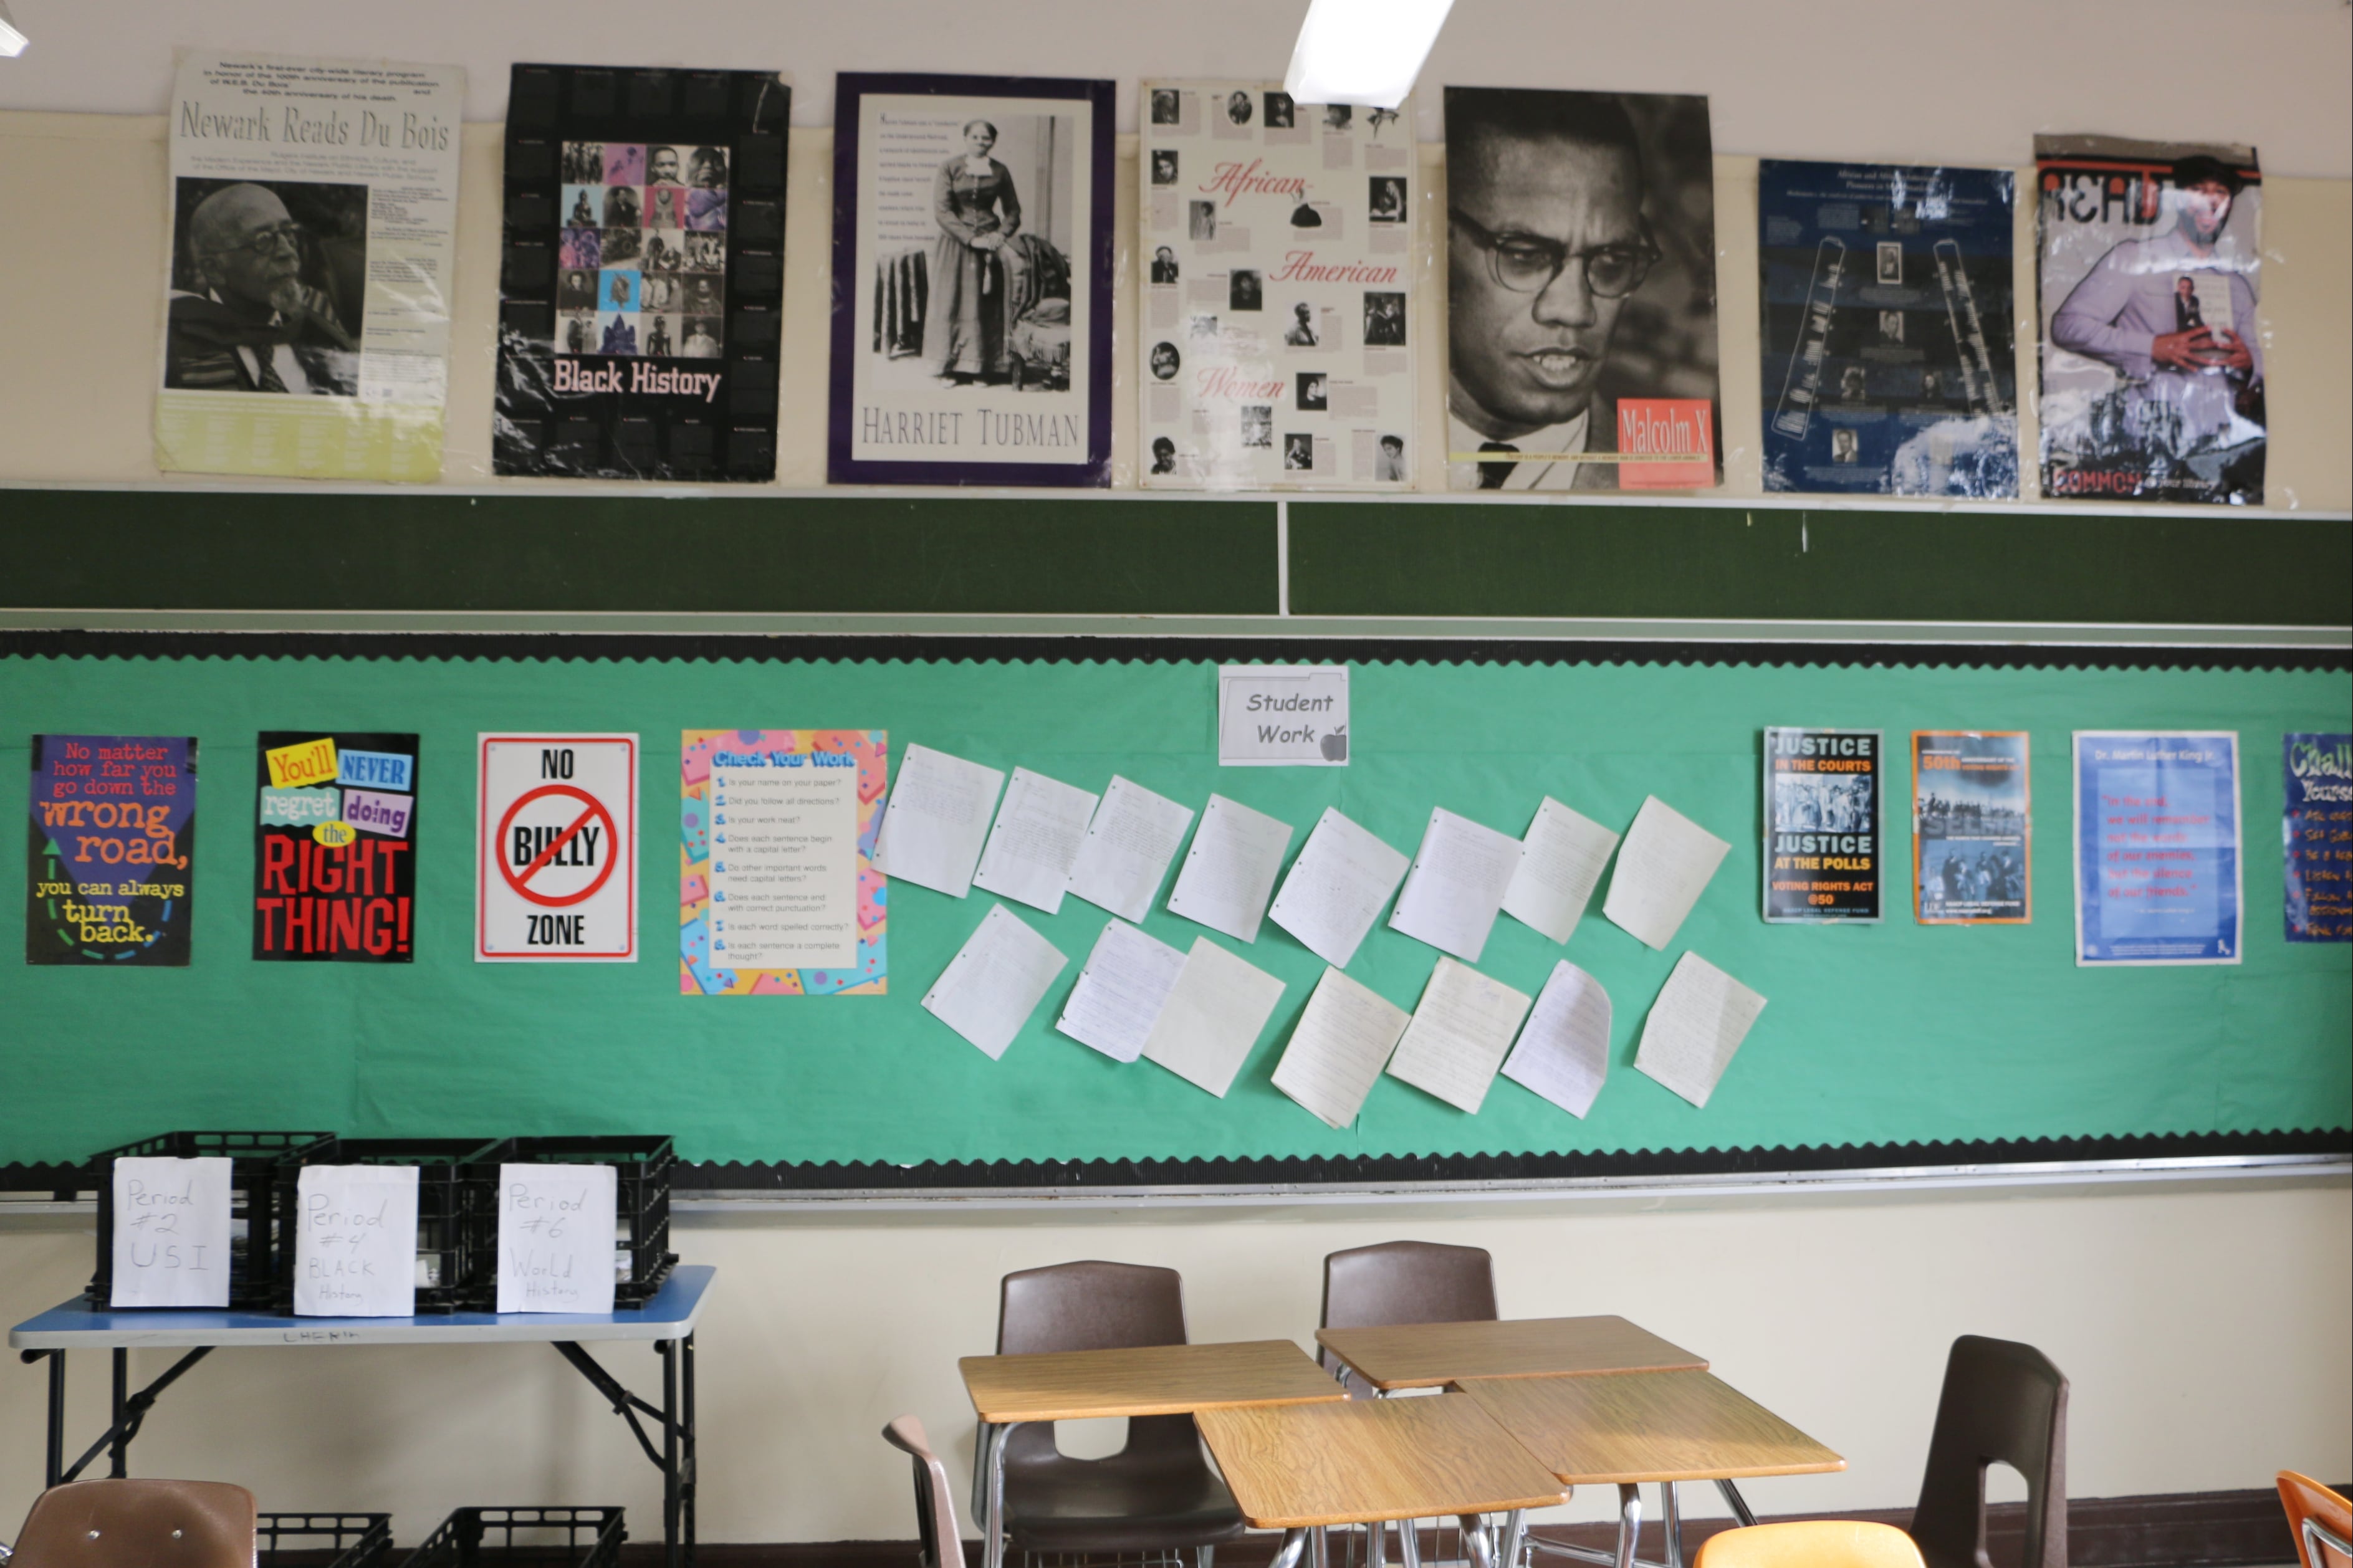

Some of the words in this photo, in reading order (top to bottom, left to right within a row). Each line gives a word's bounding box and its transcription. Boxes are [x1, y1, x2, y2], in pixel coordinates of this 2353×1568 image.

[386, 71, 425, 79] program
[180, 100, 271, 141] Newark
[282, 106, 348, 145] Reads
[359, 110, 390, 147] Du
[401, 112, 449, 151] Bois
[1198, 157, 1313, 208] African-
[2039, 167, 2164, 224] READ
[1268, 250, 1397, 284] American
[554, 358, 623, 394] Black
[630, 361, 721, 403] History
[1197, 366, 1285, 399] Women
[862, 406, 963, 446] HARRIET
[977, 408, 1078, 447] TUBMAN
[1622, 407, 1691, 453] Malcolm
[1696, 409, 1707, 453] X
[1246, 693, 1334, 712] Student
[1257, 724, 1315, 743] Work
[65, 743, 90, 760] No
[98, 744, 168, 760] matter
[1775, 737, 1871, 756] JUSTICE
[274, 745, 333, 783] You'll
[344, 755, 405, 785] NEVER
[541, 749, 574, 779] NO
[712, 750, 766, 768] Check
[770, 750, 808, 768] Your
[811, 750, 855, 768] Work
[1775, 759, 1788, 771] IN
[1791, 759, 1816, 771] THE
[1818, 760, 1871, 772] COURTS
[1923, 755, 1961, 770] 50th
[2112, 750, 2144, 760] Martin
[2146, 750, 2177, 760] Luther
[2179, 750, 2203, 763] King
[53, 761, 92, 776] how
[100, 761, 137, 777] far
[141, 765, 176, 780] you
[52, 781, 77, 798] go
[84, 779, 134, 795] down
[141, 780, 176, 795] the
[738, 780, 755, 788] your
[794, 780, 812, 788] your
[813, 778, 841, 788] paper?
[729, 796, 741, 805] Did
[744, 798, 758, 807] you
[760, 796, 783, 805] follow
[786, 796, 794, 805] all
[797, 796, 839, 805] directions?
[2124, 795, 2140, 806] the
[39, 801, 171, 838] wrong
[264, 791, 337, 821] regret
[347, 795, 406, 833] doing
[2107, 815, 2124, 824] we
[2128, 813, 2147, 824] will
[2153, 814, 2210, 824] remember
[738, 818, 755, 826] your
[323, 825, 347, 843] the
[811, 834, 832, 844] begin
[2107, 833, 2126, 842] not
[2130, 832, 2148, 842] the
[2154, 832, 2188, 842] words
[74, 831, 188, 870] road,
[514, 826, 600, 866] BULLY
[754, 846, 779, 855] capital
[781, 845, 806, 853] letter?
[1774, 835, 1872, 854] JUSTICE
[262, 834, 409, 896] RIGHT
[1774, 857, 1791, 869] AT
[1793, 857, 1820, 869] THE
[1823, 857, 1871, 870] POLLS
[2107, 850, 2120, 863] of
[2123, 851, 2142, 861] our
[764, 864, 800, 874] important
[2109, 868, 2127, 878] but
[2132, 868, 2149, 878] the
[2154, 868, 2192, 878] silence
[750, 875, 775, 884] capital
[1771, 882, 1809, 891] VOTING
[1811, 882, 1851, 891] RIGHTS
[1852, 882, 1874, 891] ACT
[36, 882, 71, 897] you
[77, 882, 113, 895] can
[118, 880, 185, 899] always
[2109, 886, 2120, 899] of
[2124, 888, 2144, 897] our
[775, 904, 825, 914] punctuation?
[1808, 894, 1834, 906] @50
[62, 899, 132, 923] turn
[79, 919, 155, 943] back.
[256, 897, 410, 956] THING!
[527, 914, 585, 945] ZONE
[780, 923, 808, 933] spelled
[810, 923, 849, 933] correctly?
[804, 942, 840, 952] complete
[728, 952, 762, 962] thought?
[128, 1180, 194, 1211] Period
[509, 1183, 587, 1212] Period
[308, 1193, 388, 1232] Period
[130, 1213, 179, 1235] #2
[519, 1216, 567, 1238] #6
[319, 1232, 367, 1254] #4
[309, 1258, 375, 1280] BLACK
[319, 1284, 363, 1306] History
[526, 1281, 579, 1304] History
